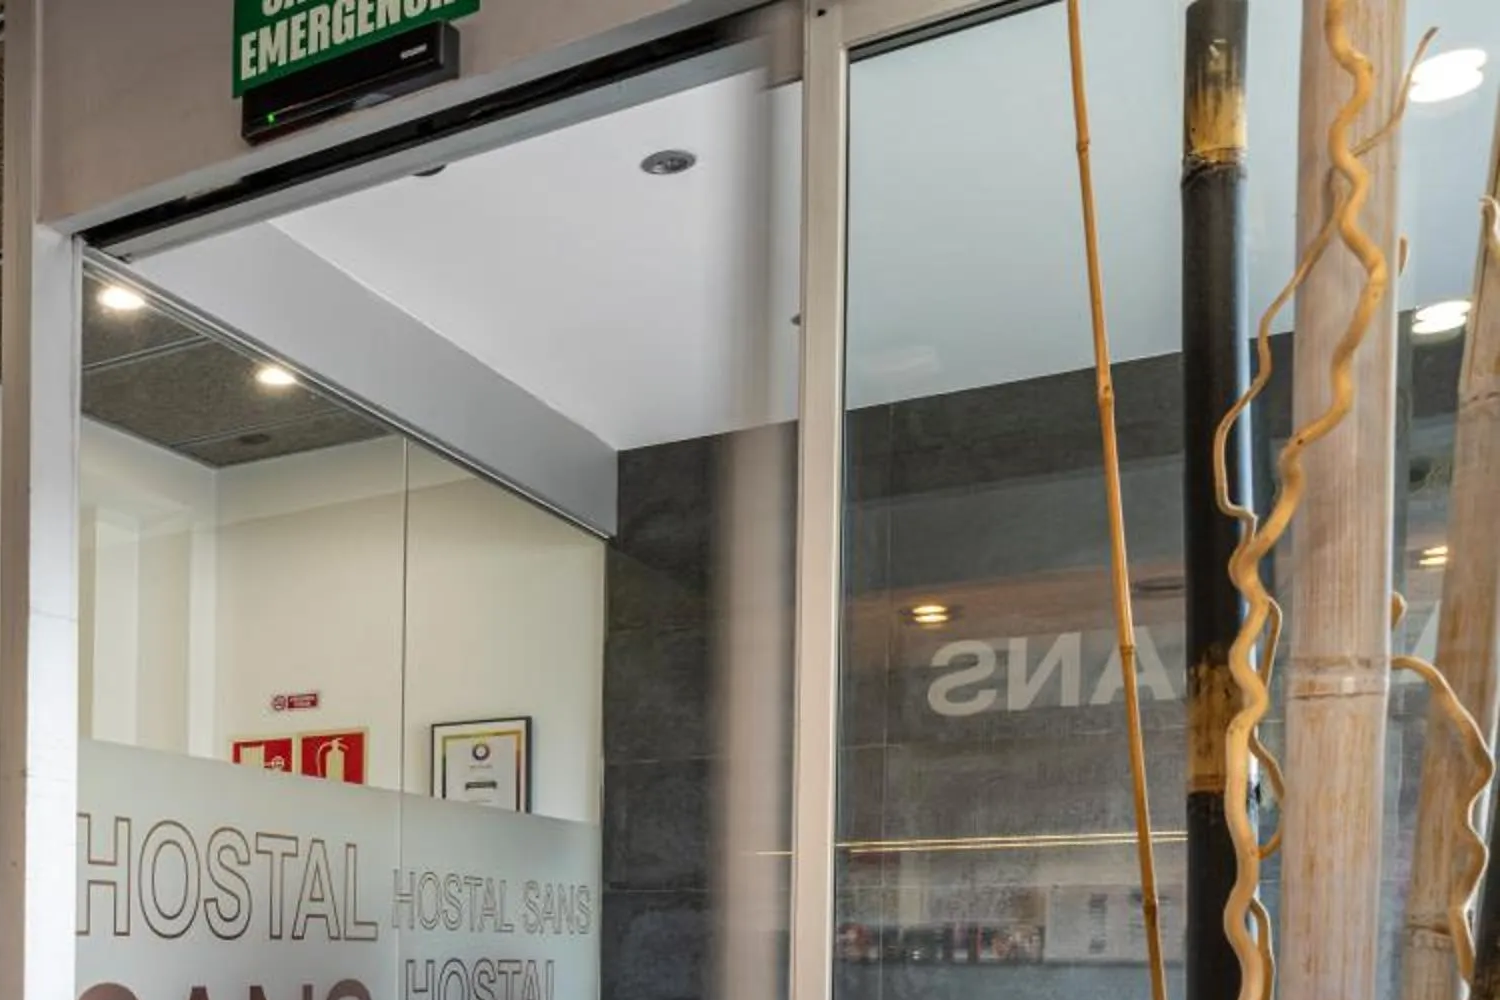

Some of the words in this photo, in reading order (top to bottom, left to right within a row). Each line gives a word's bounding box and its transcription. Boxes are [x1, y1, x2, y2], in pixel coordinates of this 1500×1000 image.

[76, 812, 378, 942] HOSTAL
[393, 867, 514, 934] HOSTAL
[522, 880, 592, 935] SANS
